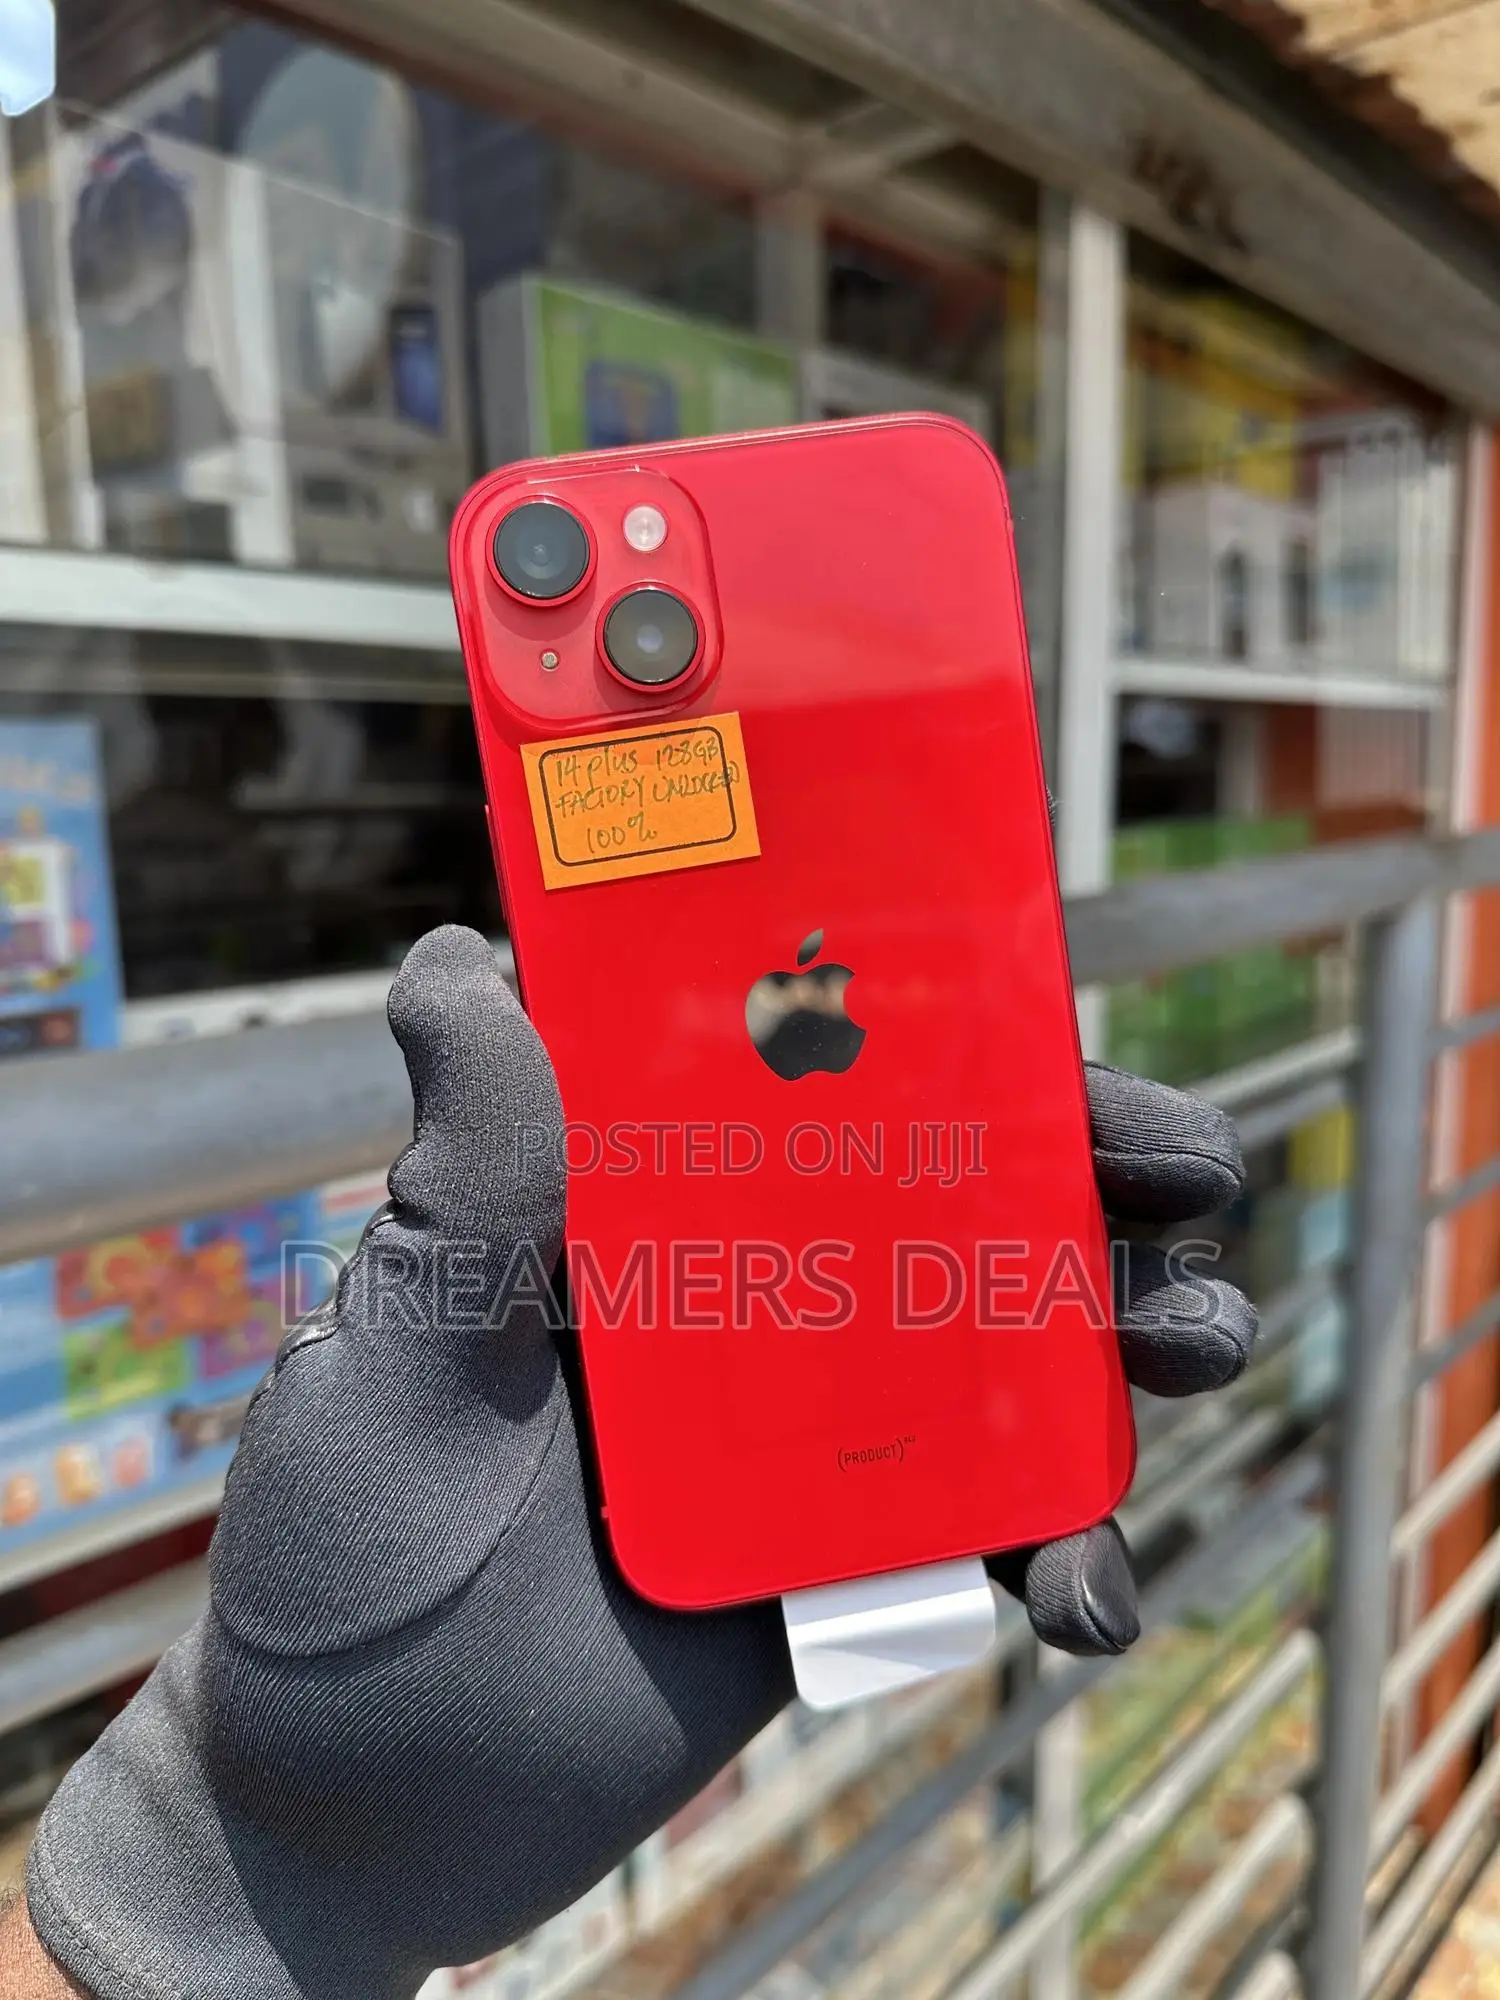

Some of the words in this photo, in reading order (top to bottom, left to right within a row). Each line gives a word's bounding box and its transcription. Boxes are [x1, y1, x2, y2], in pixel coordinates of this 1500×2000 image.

[556, 754, 580, 787] 14
[555, 776, 646, 818] FACTORY
[586, 811, 657, 854] 100%
